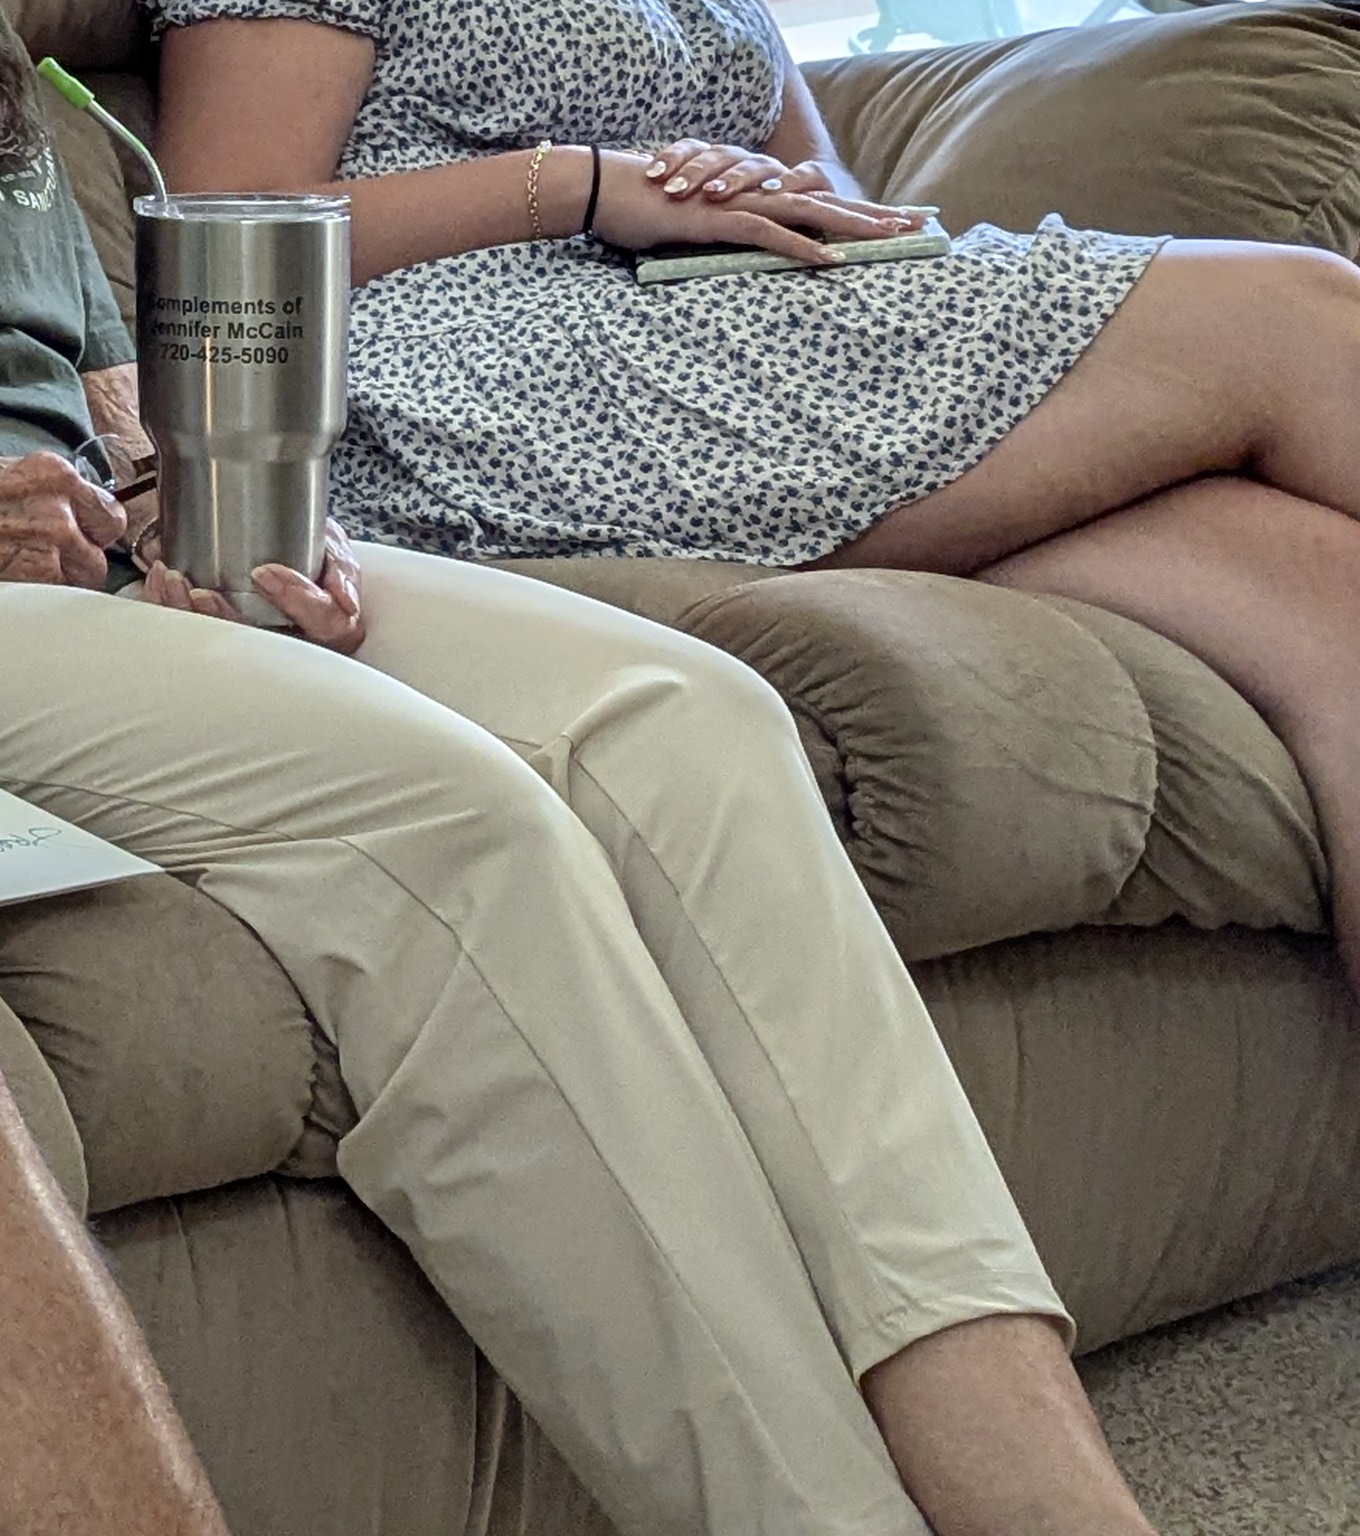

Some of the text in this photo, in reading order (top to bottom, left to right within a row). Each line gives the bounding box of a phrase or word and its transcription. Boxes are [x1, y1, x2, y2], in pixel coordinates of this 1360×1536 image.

[282, 296, 303, 315] of
[150, 318, 304, 340] Jennifer McCain
[160, 343, 290, 364] 720-425-5090
